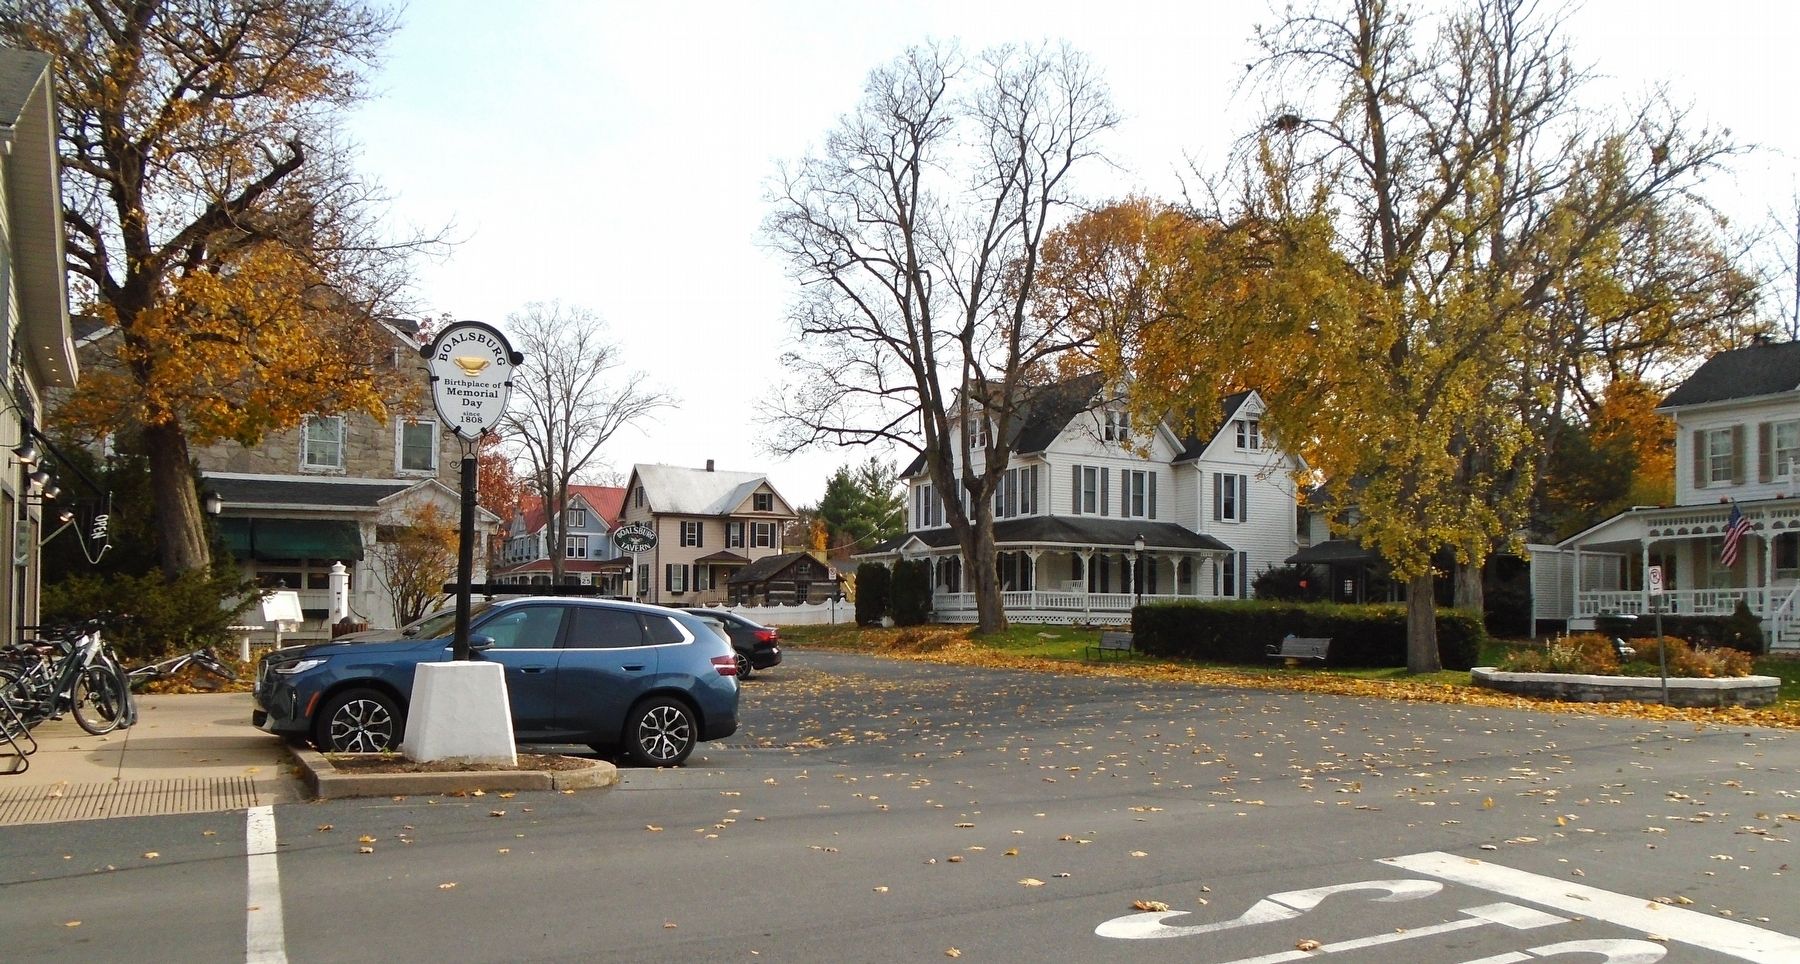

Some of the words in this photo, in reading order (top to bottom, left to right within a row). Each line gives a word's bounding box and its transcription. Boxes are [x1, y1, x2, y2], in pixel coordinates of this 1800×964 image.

[439, 332, 505, 366] BOALSBURG
[444, 379, 489, 388] Birthplace
[447, 388, 498, 398] Memorial
[462, 399, 482, 409] Day
[91, 514, 108, 539] OPEN
[617, 527, 654, 540] BOALSBURG
[621, 542, 651, 552] TAVERN
